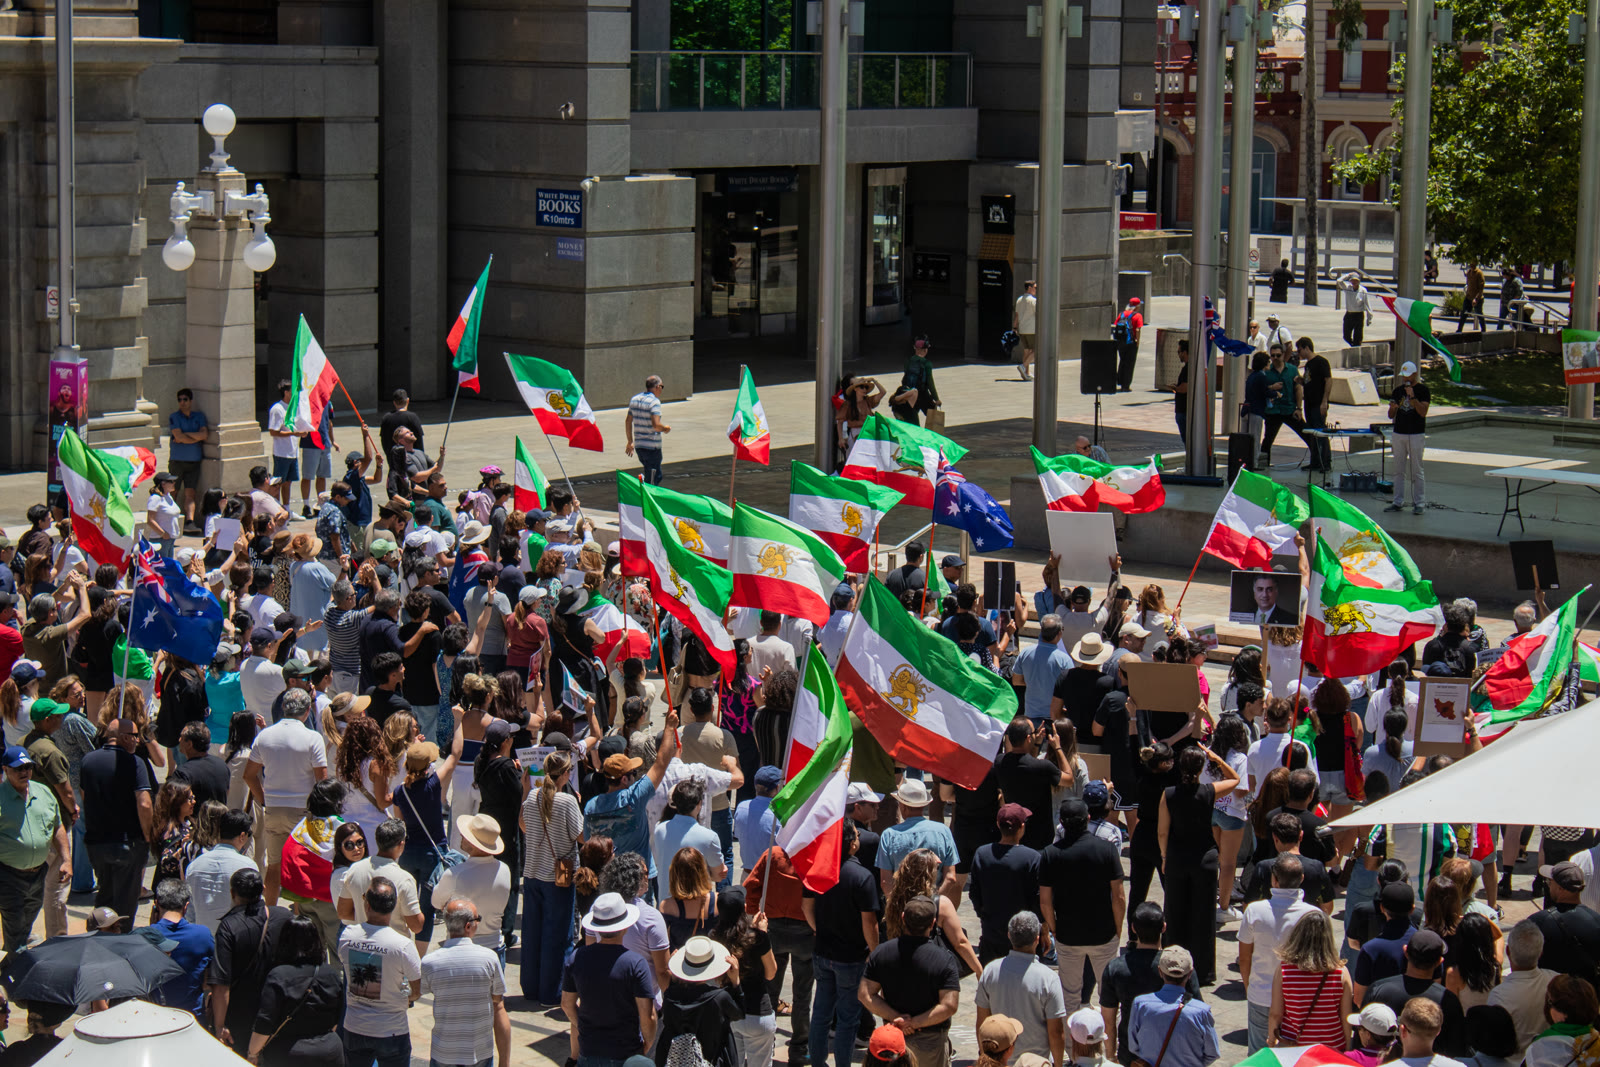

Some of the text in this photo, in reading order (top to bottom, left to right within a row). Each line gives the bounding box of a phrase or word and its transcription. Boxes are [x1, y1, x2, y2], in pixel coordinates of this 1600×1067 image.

[538, 191, 580, 201] WHITE DWARF
[538, 199, 581, 214] BOOKS
[550, 214, 575, 225] 10mtrs
[558, 242, 583, 251] MONEY
[557, 249, 583, 257] EXCHANGE
[347, 940, 388, 954] LAS PALMAS
